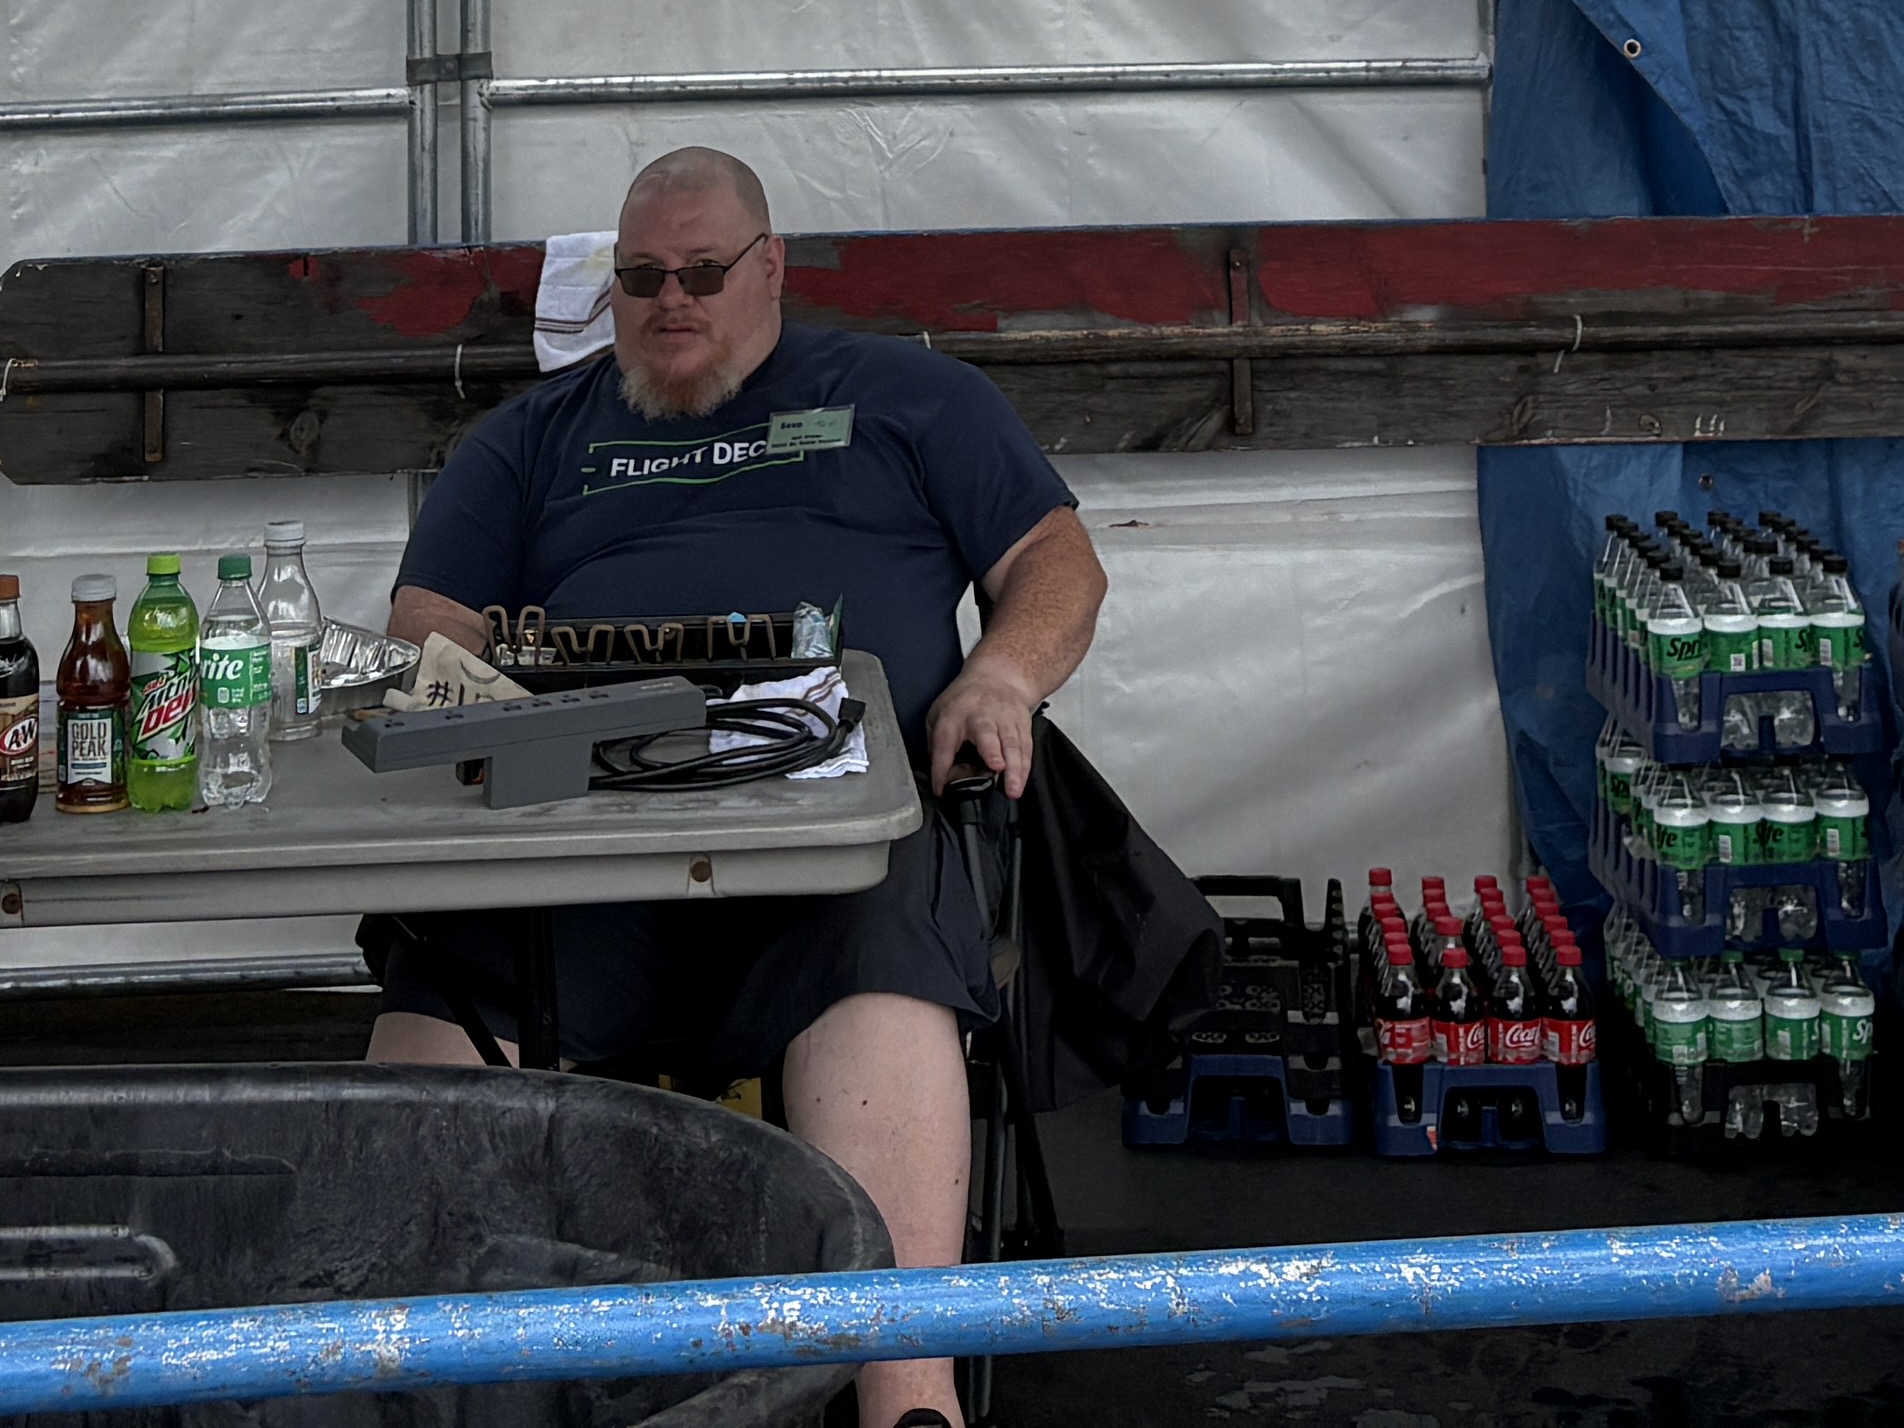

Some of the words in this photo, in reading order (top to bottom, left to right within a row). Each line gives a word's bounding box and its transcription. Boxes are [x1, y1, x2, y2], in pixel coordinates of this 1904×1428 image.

[610, 446, 709, 477] FLIGHT
[713, 440, 767, 465] DEC
[201, 653, 244, 680] rite
[71, 721, 107, 740] GOLD
